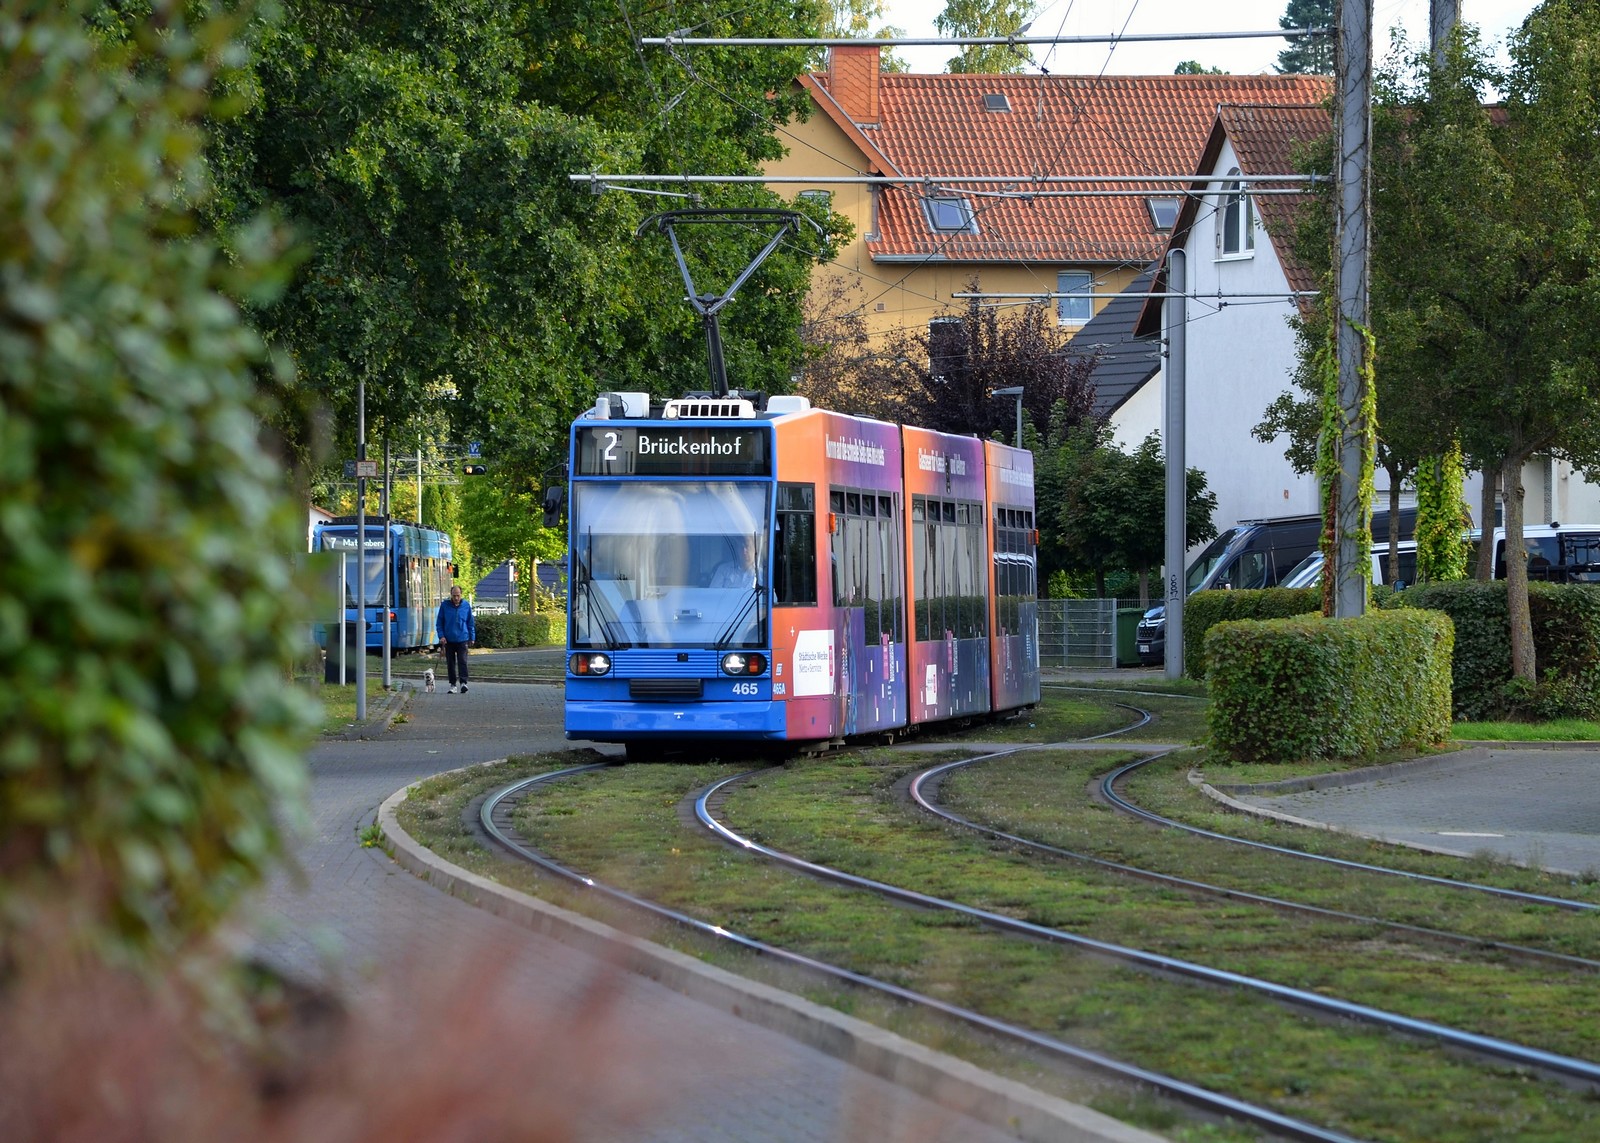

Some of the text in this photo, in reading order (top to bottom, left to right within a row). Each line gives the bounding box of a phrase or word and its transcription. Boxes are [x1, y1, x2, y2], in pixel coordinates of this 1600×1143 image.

[604, 432, 742, 461] 2 Brückenhof
[330, 537, 336, 548] 7
[732, 683, 758, 695] 465
[772, 682, 786, 694] 465A
